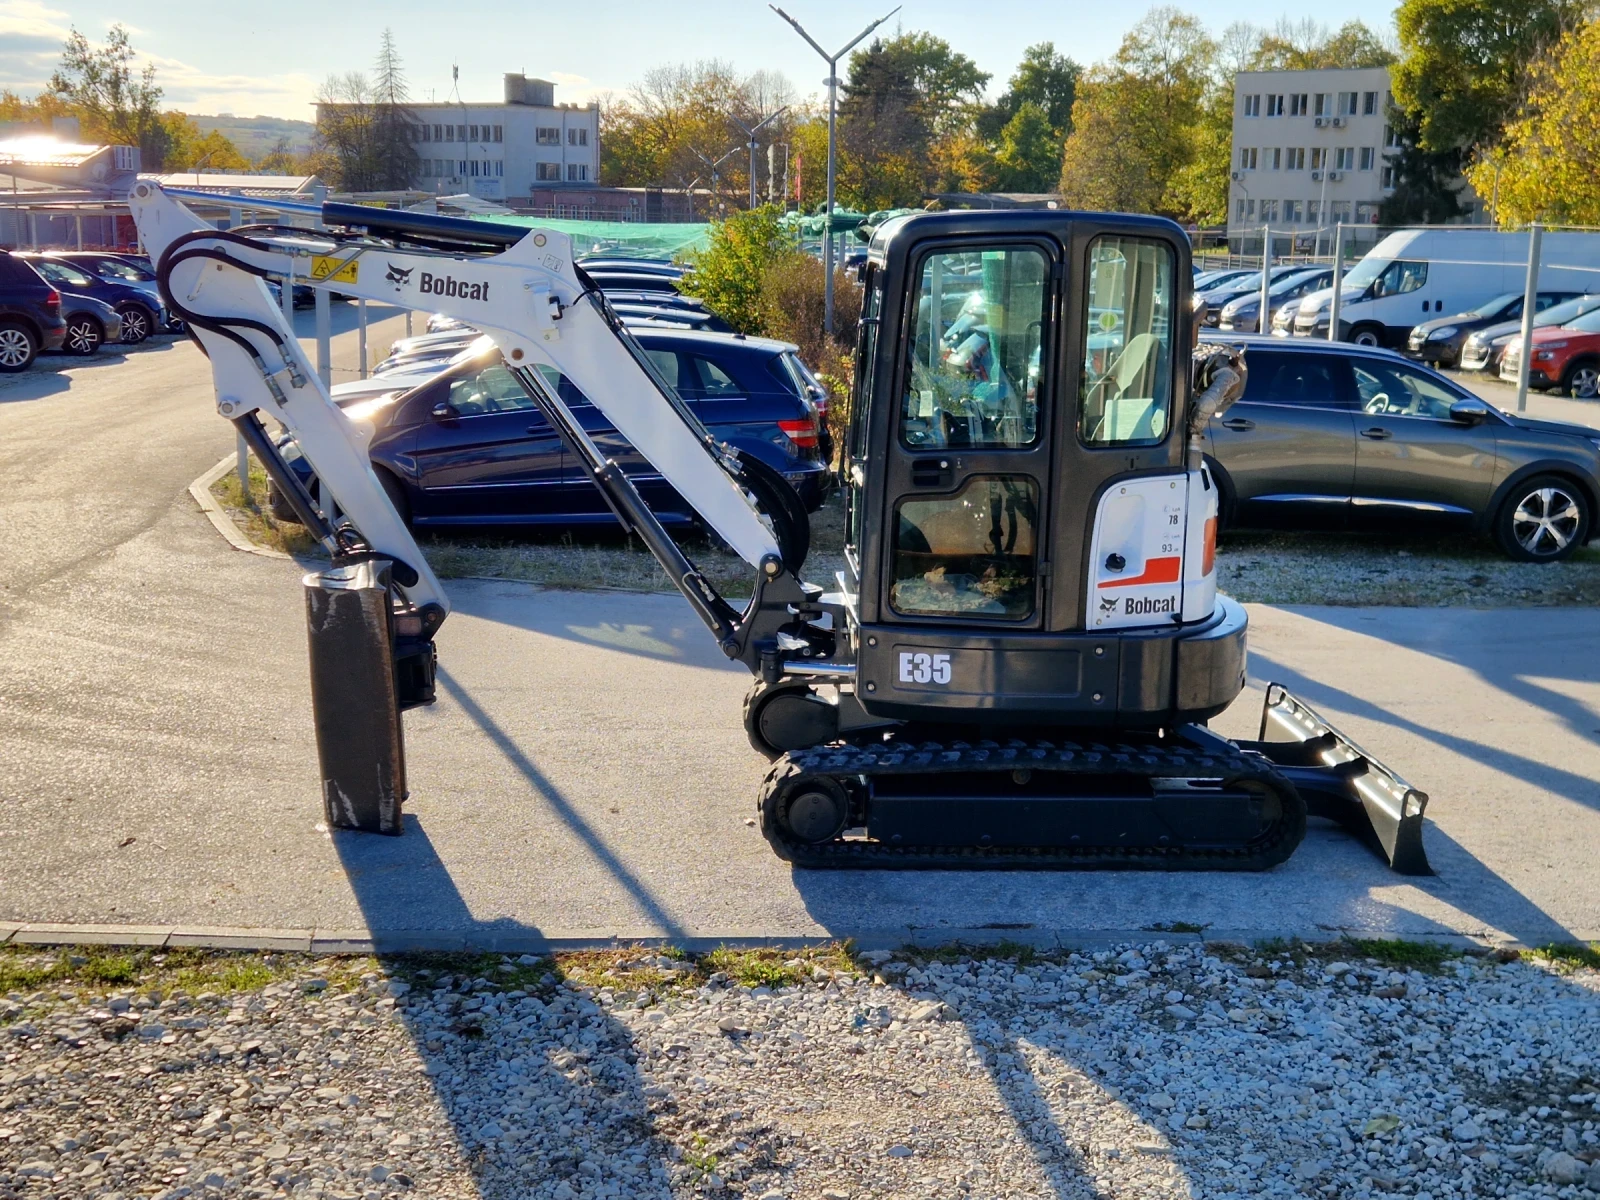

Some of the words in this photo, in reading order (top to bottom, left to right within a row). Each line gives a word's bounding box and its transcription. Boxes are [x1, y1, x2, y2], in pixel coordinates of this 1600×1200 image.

[419, 272, 489, 301] Bobcat
[1169, 514, 1178, 525] 78
[1161, 543, 1173, 553] 93
[1125, 595, 1175, 615] Bobcat
[899, 652, 951, 684] E35
